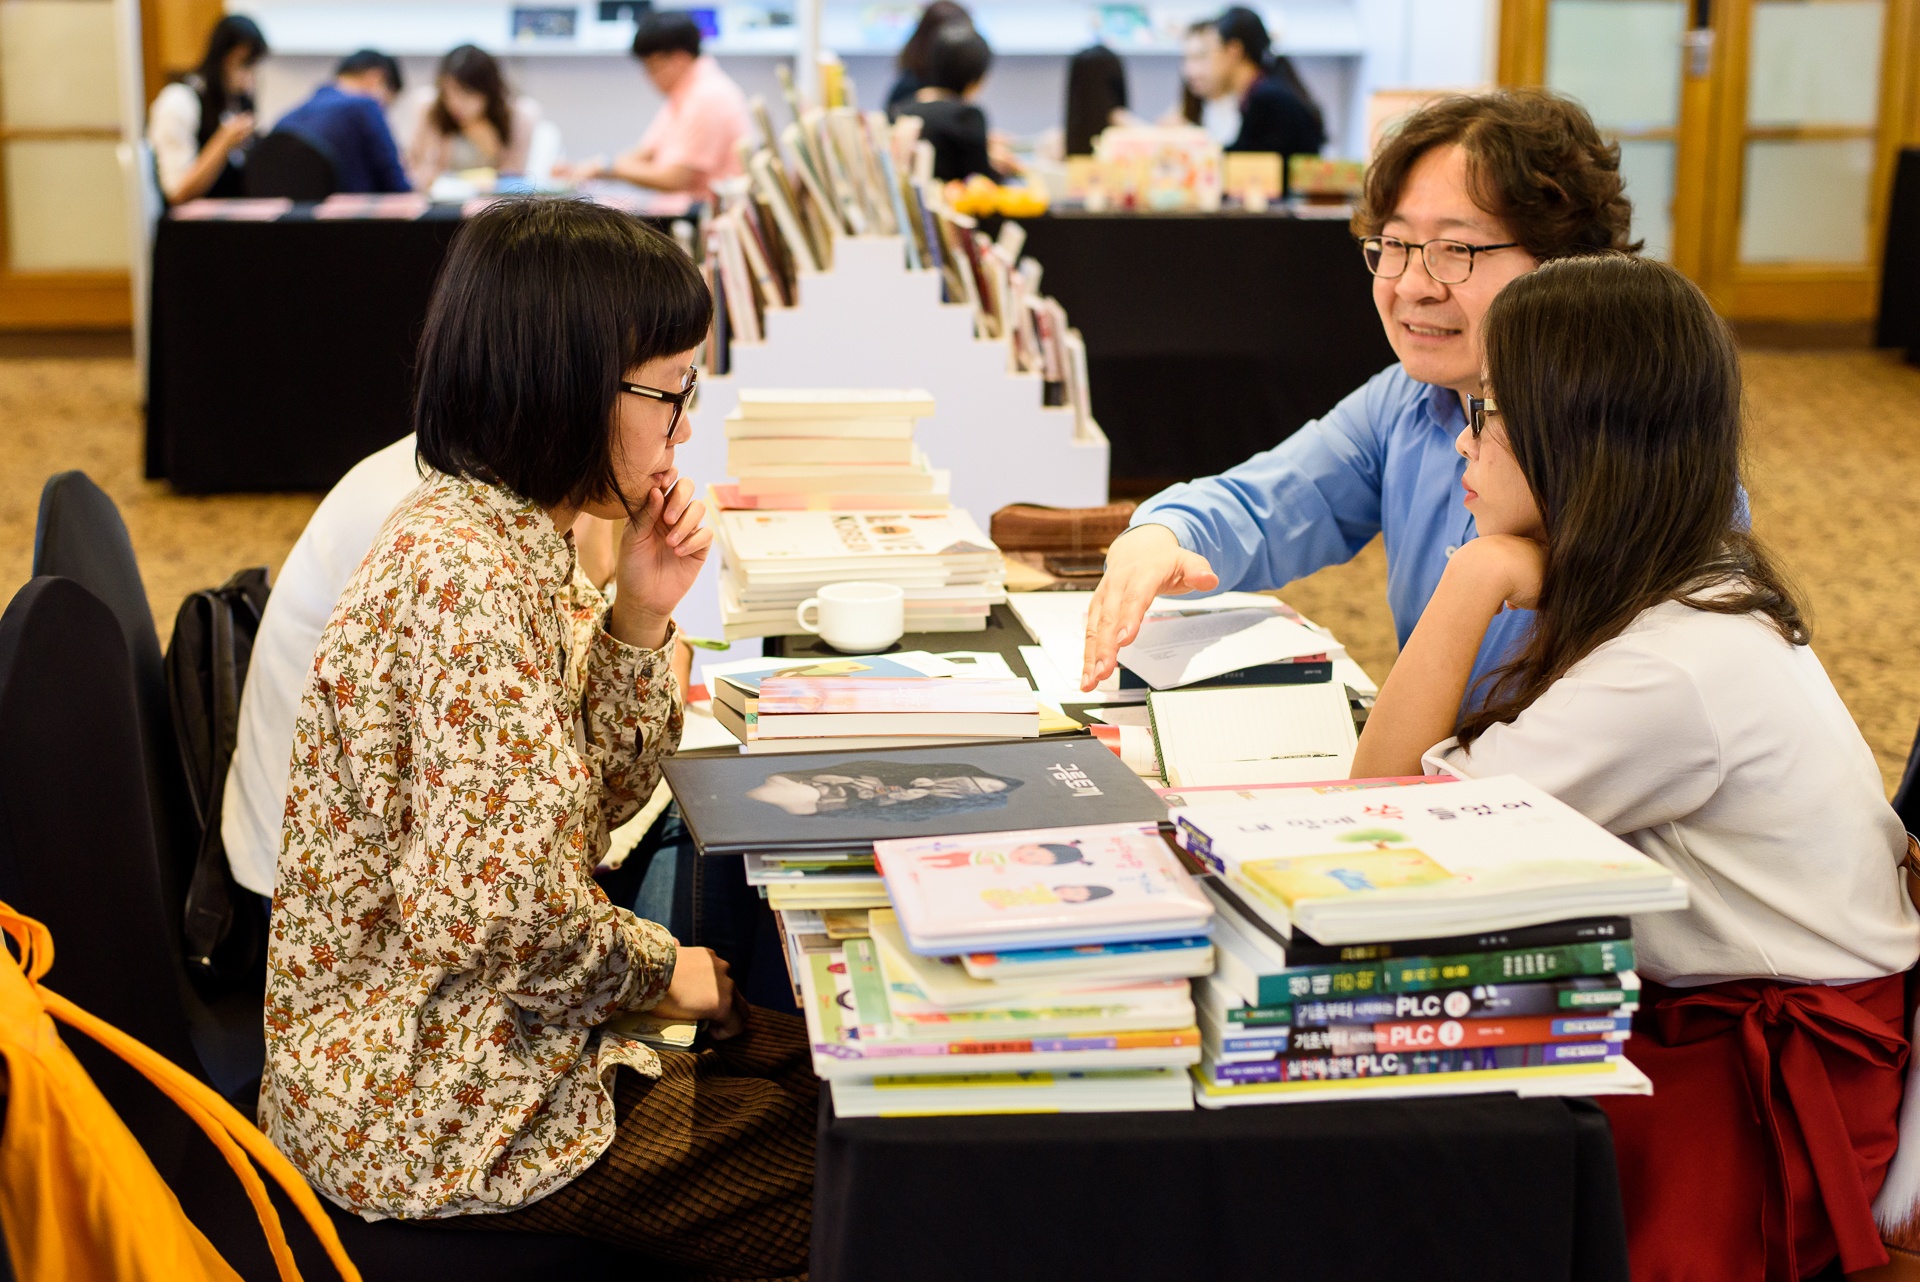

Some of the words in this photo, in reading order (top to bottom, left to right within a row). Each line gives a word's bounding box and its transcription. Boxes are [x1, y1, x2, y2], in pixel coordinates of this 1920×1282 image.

[1396, 995, 1441, 1018] PLC
[1390, 1024, 1435, 1046] PLC
[1356, 1053, 1399, 1074] PLC
